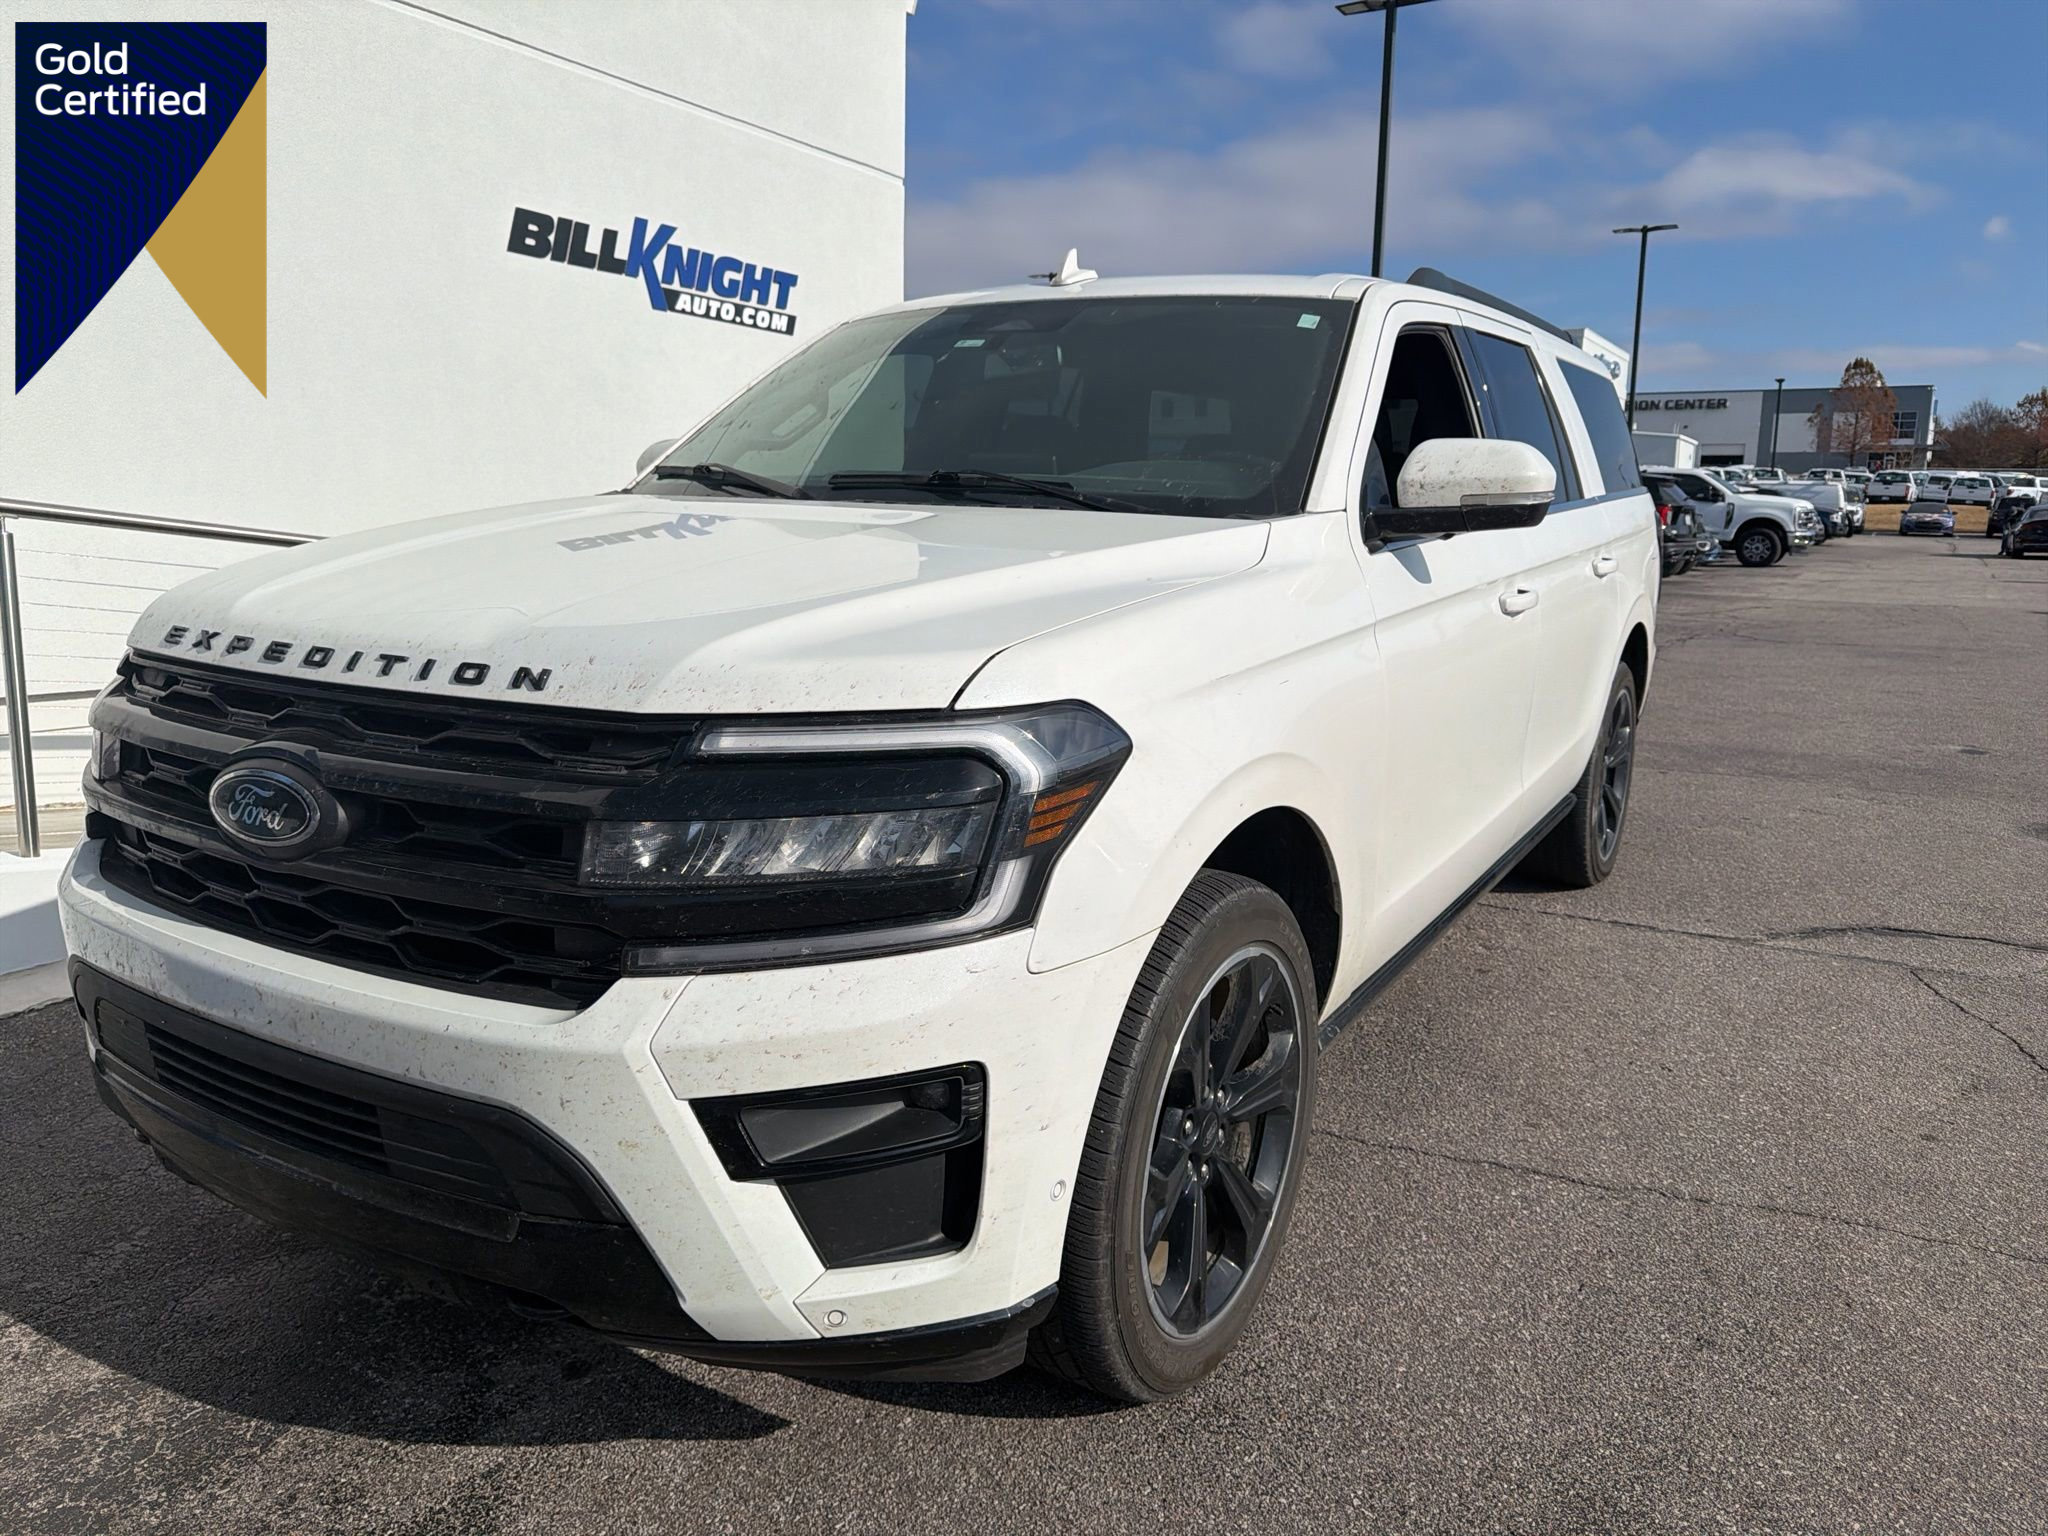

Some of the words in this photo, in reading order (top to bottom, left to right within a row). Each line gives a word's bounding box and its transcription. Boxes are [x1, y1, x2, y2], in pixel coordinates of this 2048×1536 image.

[674, 292, 791, 333] AUTO.COM
[1664, 398, 1729, 411] CENTER
[162, 624, 553, 692] EXPEDITION
[228, 783, 289, 831] Ford
